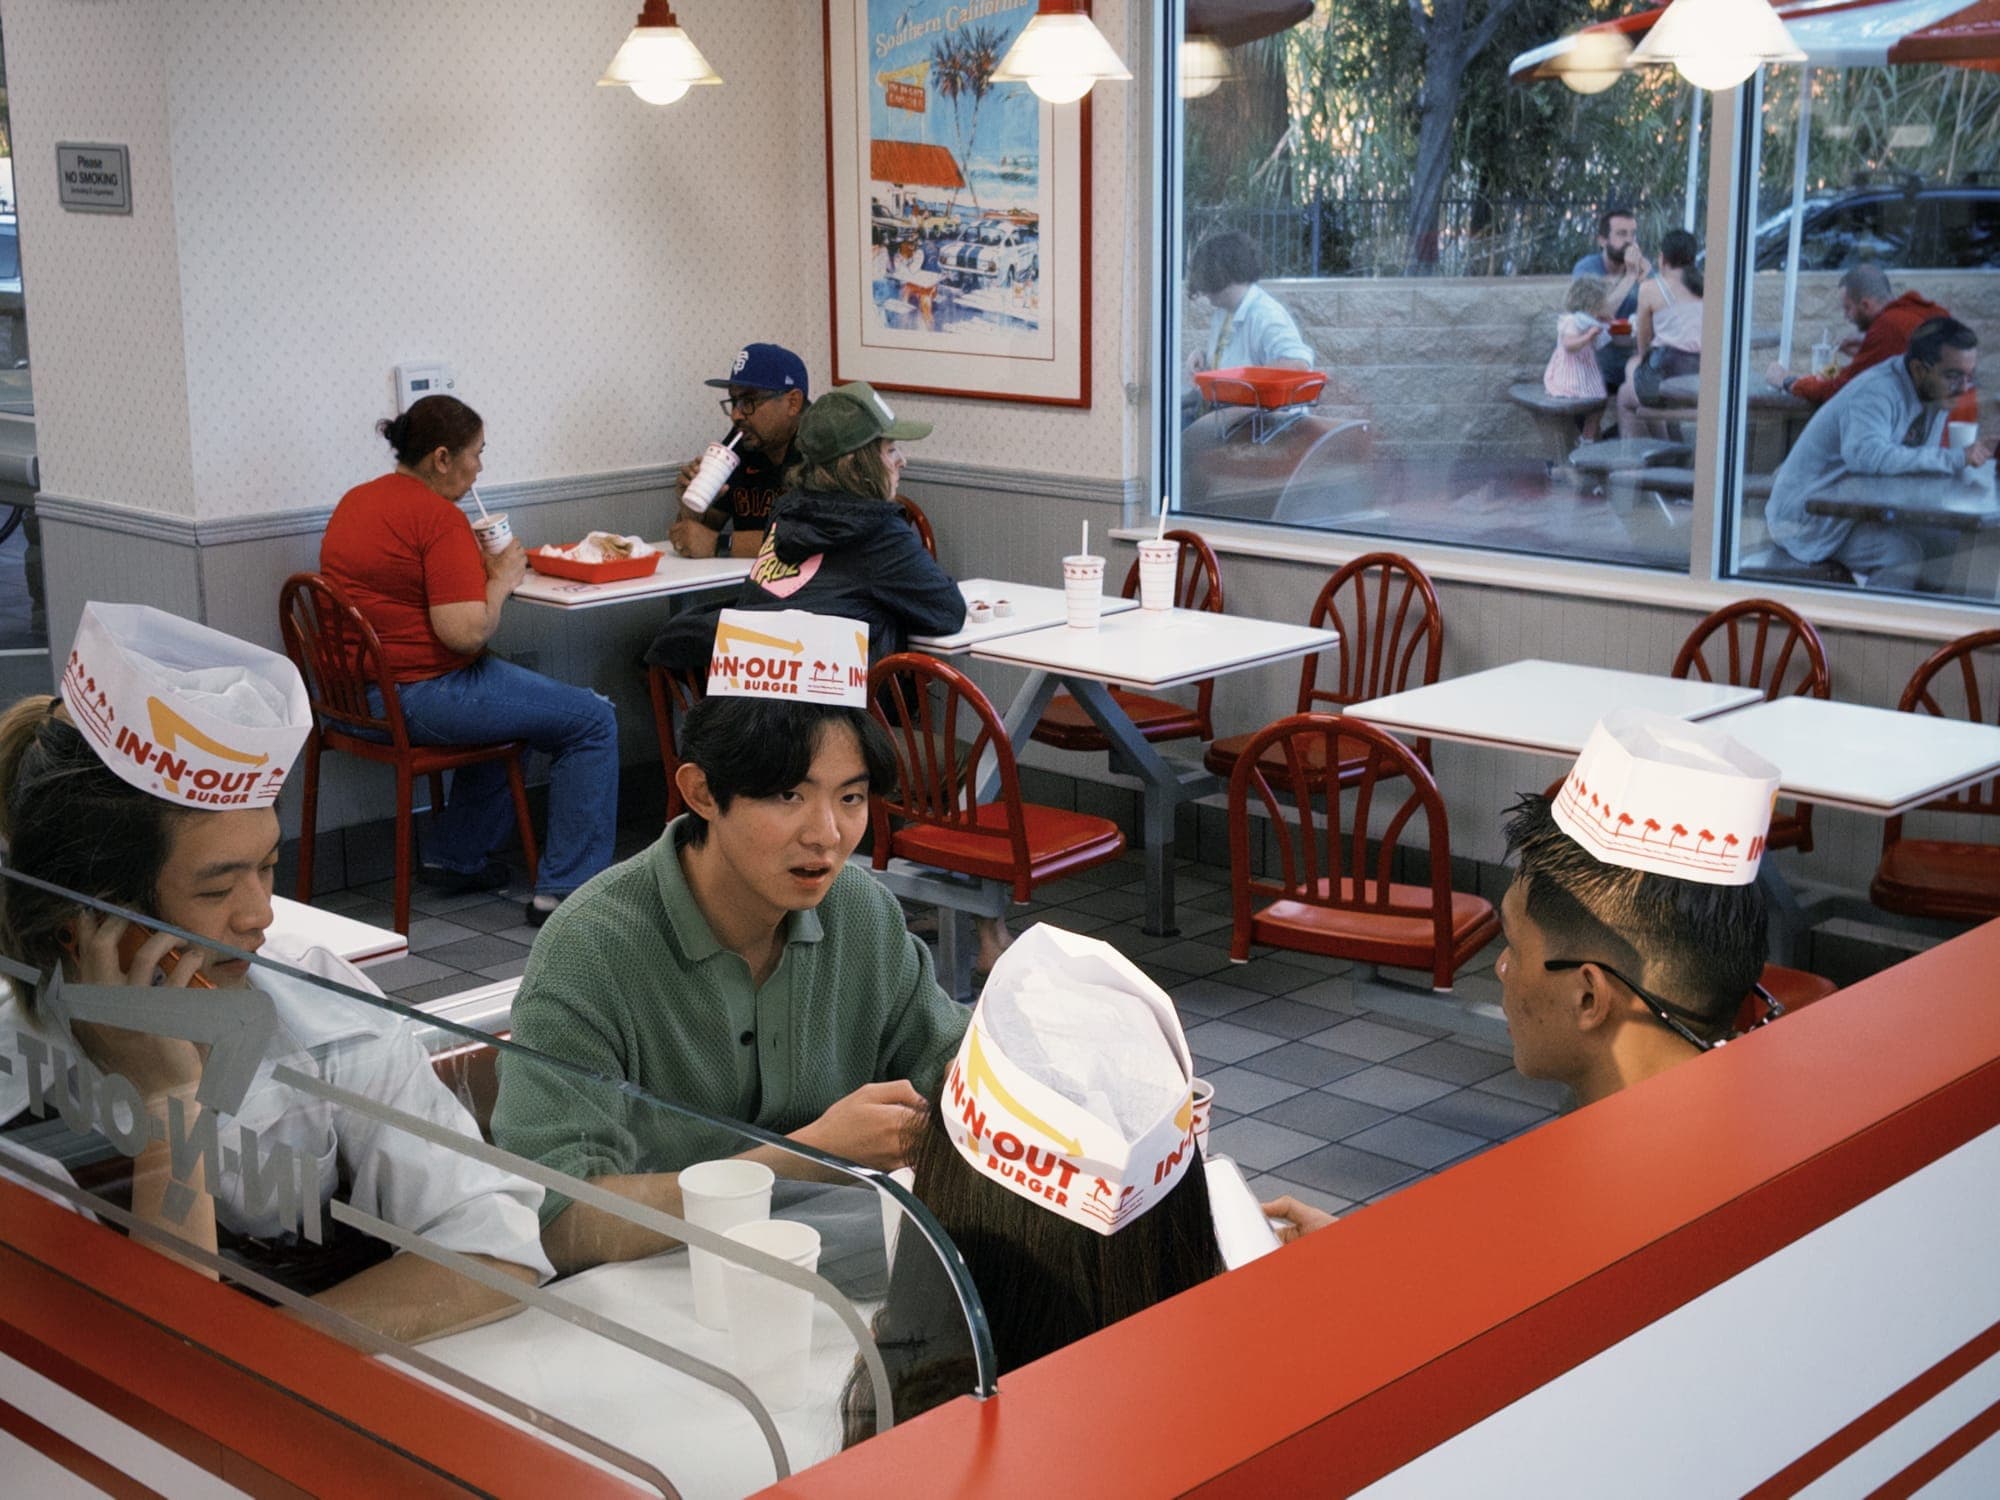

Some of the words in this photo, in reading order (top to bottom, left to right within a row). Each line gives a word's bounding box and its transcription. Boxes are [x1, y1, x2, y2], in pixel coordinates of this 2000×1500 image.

[875, 15, 942, 57] Southern
[77, 155, 102, 168] Please
[65, 171, 77, 184] NO
[79, 171, 118, 186] SMOKING
[744, 680, 798, 694] BURGER
[115, 726, 262, 793] IN-N-OUT
[185, 789, 250, 804] BURGER
[950, 1057, 1080, 1189] IN-N-OUT
[987, 1154, 1069, 1208] BURGER
